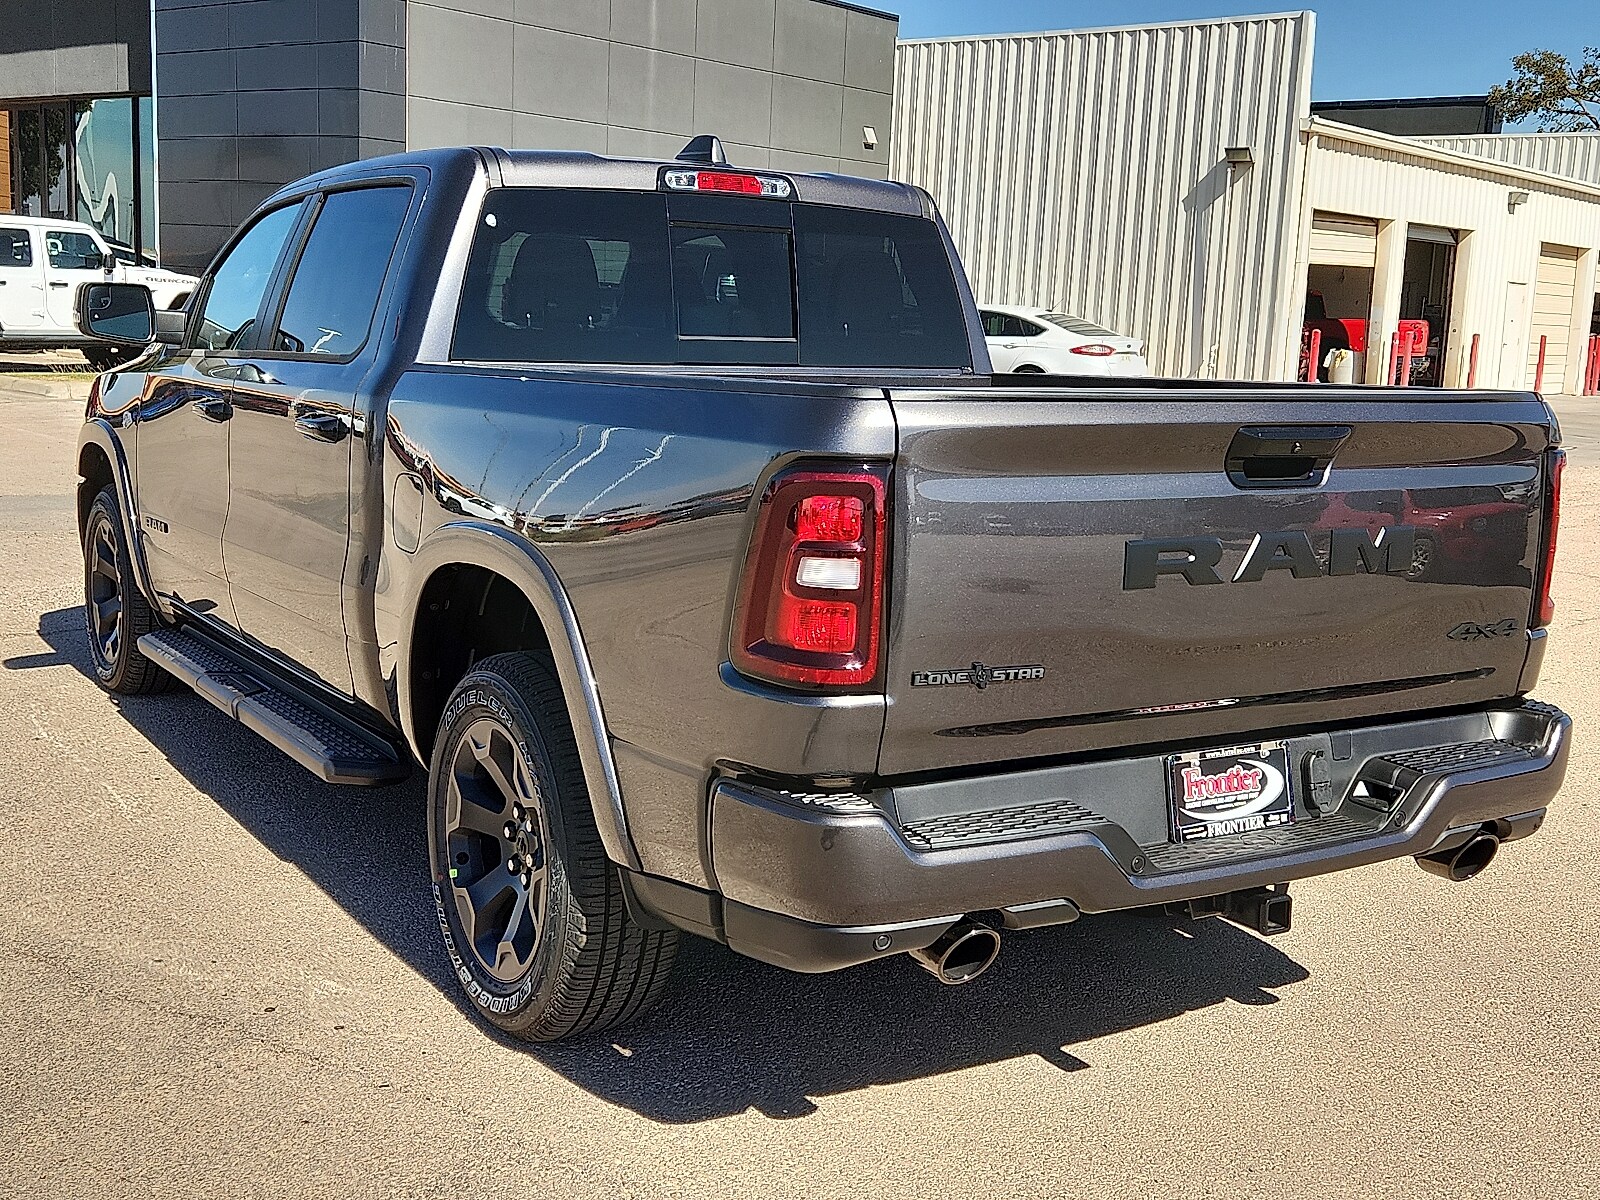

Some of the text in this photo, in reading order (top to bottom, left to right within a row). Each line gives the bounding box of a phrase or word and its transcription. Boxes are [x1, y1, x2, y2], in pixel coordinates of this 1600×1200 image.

[1123, 526, 1416, 590] RAM
[912, 667, 1046, 687] LONE STAR
[445, 690, 514, 731] DUELER
[1182, 766, 1261, 800] Frontier
[1206, 815, 1266, 838] FRONTIER
[431, 881, 534, 1014] BRIDGESTONE
